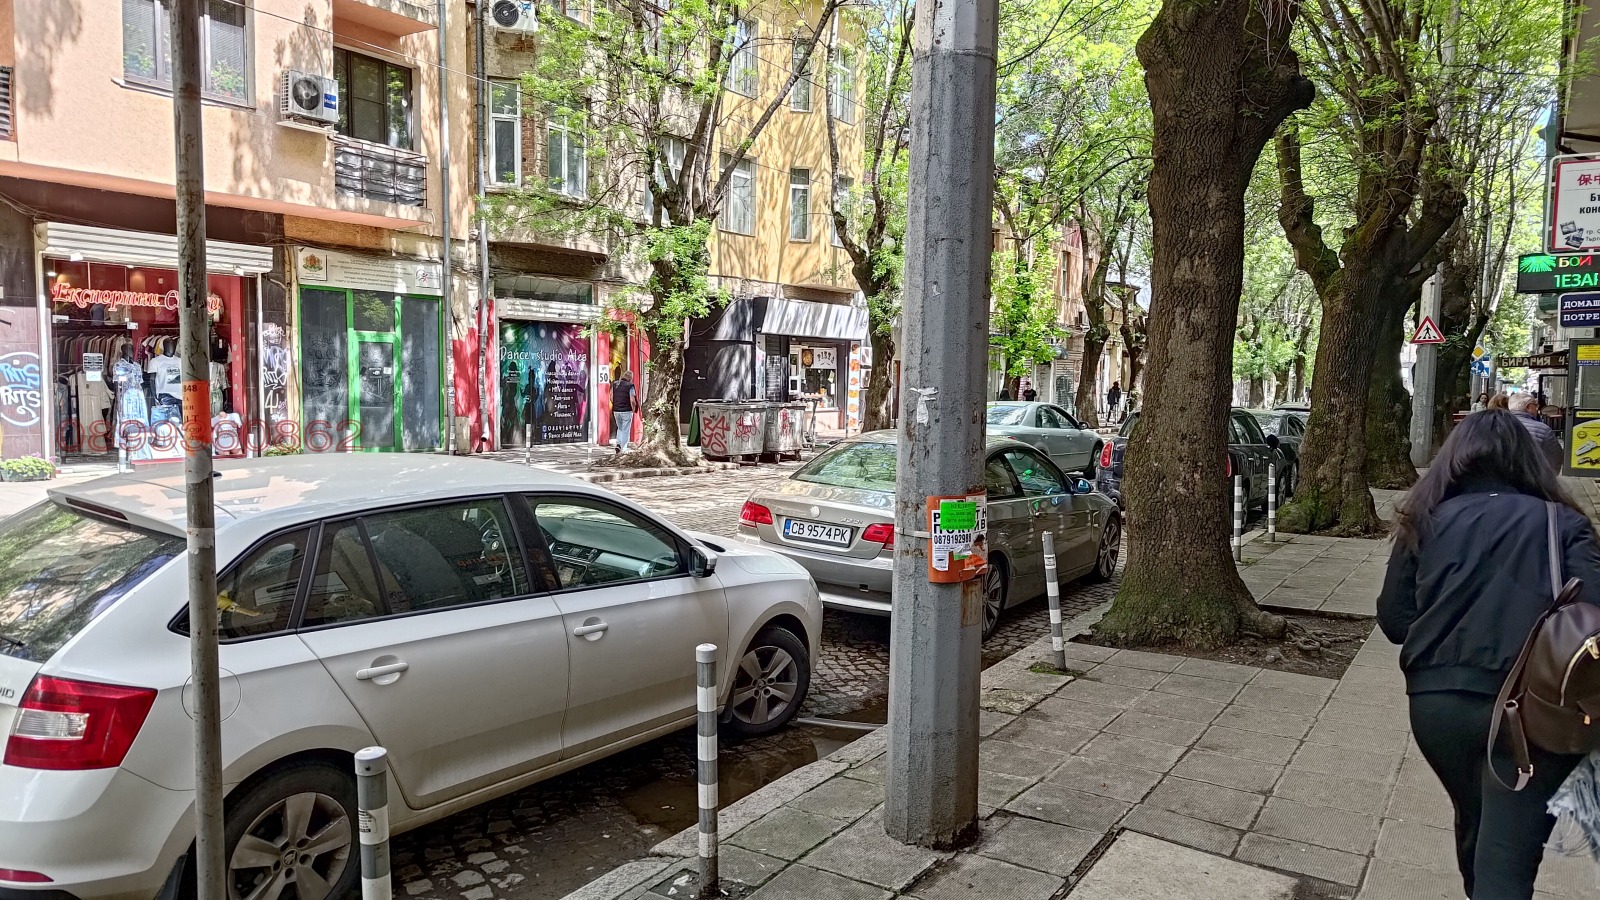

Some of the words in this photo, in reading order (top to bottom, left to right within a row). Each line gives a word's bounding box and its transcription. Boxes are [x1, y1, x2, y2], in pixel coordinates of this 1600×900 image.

[1558, 255, 1592, 268] БОИ
[51, 282, 160, 312] Експортни
[1563, 299, 1600, 309] ДОМАШ
[1563, 313, 1600, 322] ПОТРЕ
[499, 346, 529, 361] Dance
[536, 348, 563, 361] studio
[1501, 356, 1551, 367] БИРАРИЯ
[599, 372, 609, 382] 50
[791, 522, 805, 535] CB
[807, 524, 832, 539] 9574
[833, 528, 848, 542] PK
